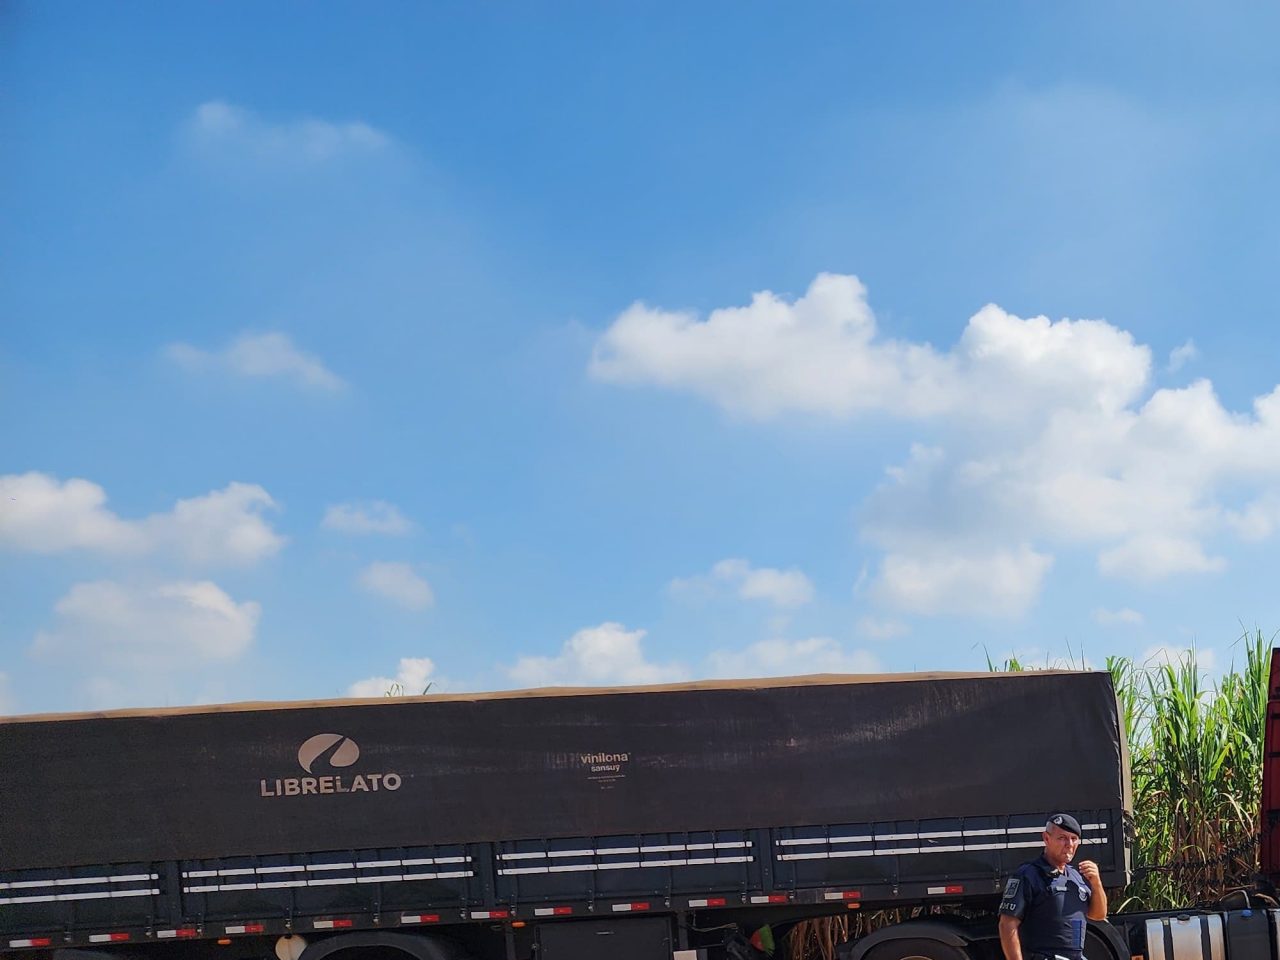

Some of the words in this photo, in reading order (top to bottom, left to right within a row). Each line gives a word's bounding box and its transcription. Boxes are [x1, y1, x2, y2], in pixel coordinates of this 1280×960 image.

[581, 752, 628, 764] vinilona
[591, 764, 620, 772] sansuy
[260, 773, 402, 797] LIBRELATO
